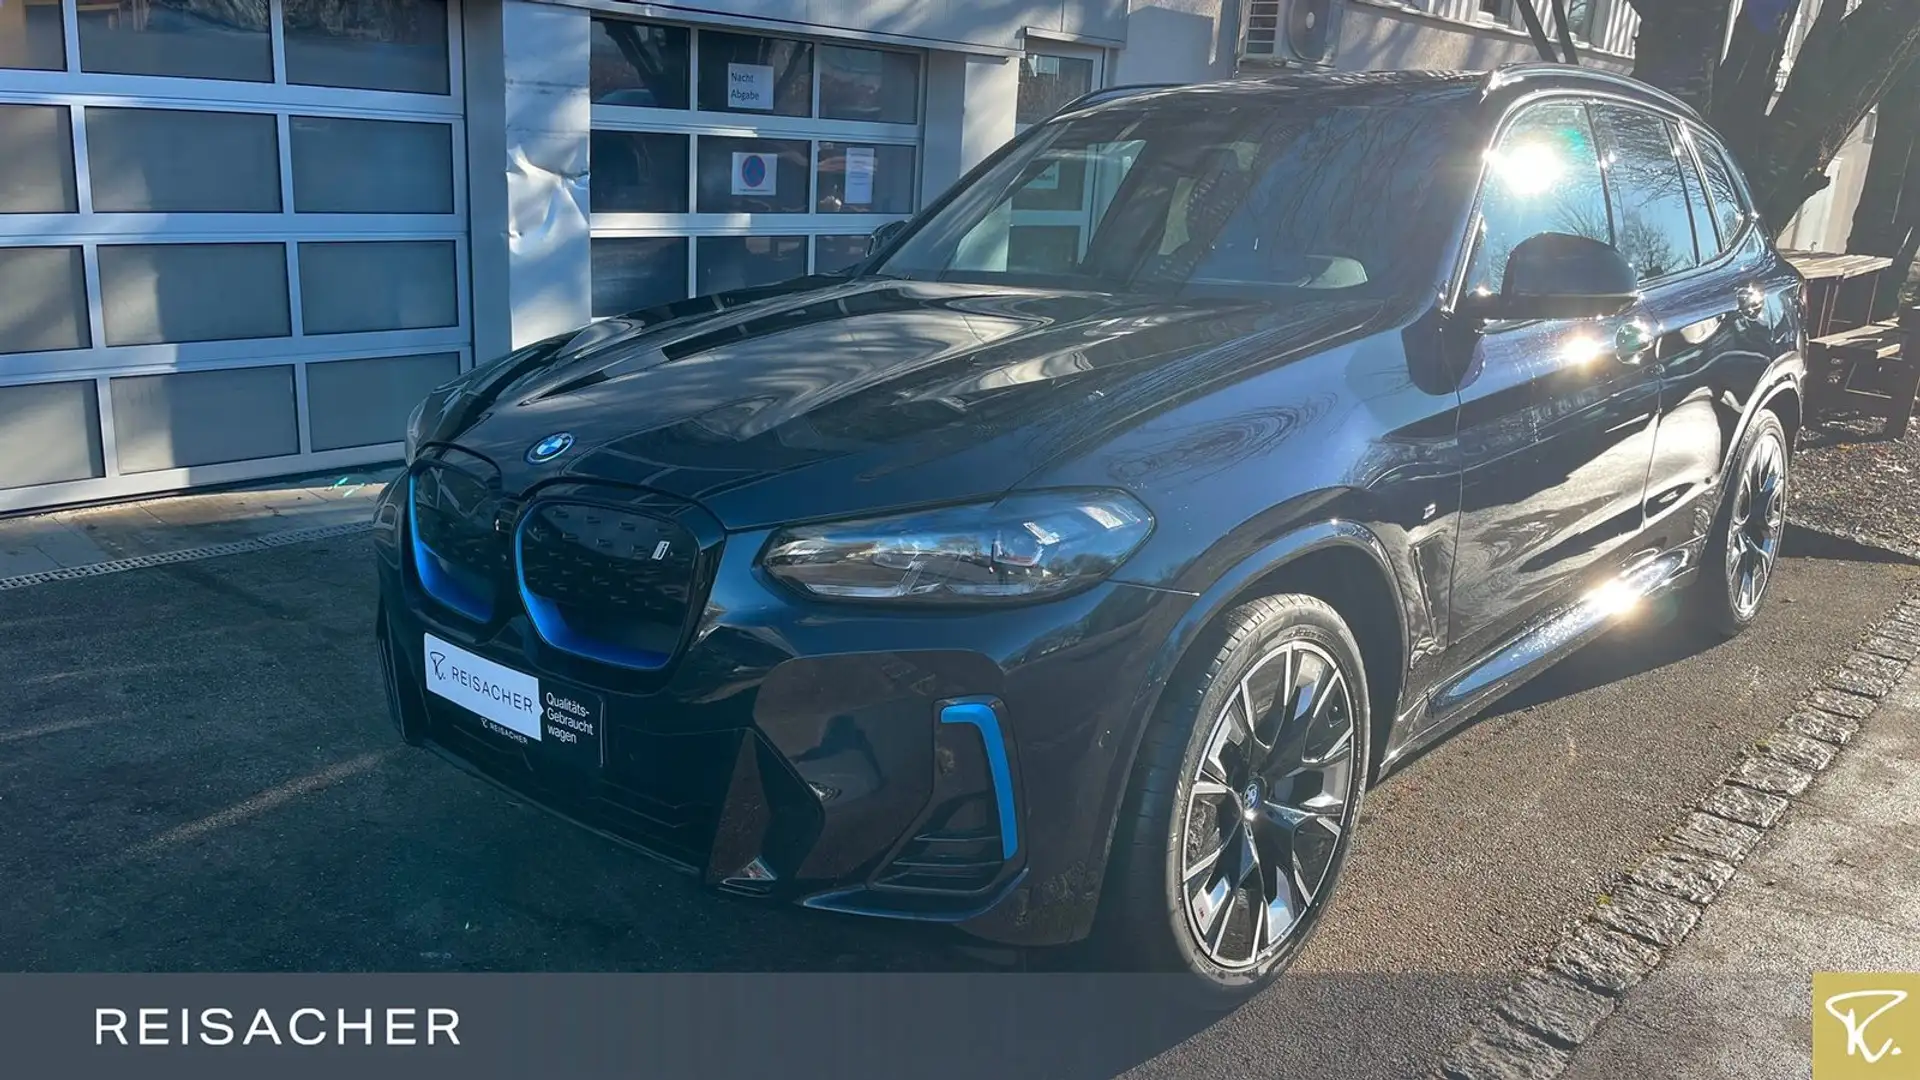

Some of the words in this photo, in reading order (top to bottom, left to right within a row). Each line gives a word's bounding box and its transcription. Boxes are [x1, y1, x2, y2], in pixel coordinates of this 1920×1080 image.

[731, 72, 754, 82] Nacht
[731, 89, 760, 102] Abgabe
[452, 666, 533, 713] REISACHER
[546, 692, 590, 716] Qualitäts-
[546, 706, 594, 736] Gebraucht
[489, 722, 529, 745] REISACHER
[547, 723, 577, 744] wagen
